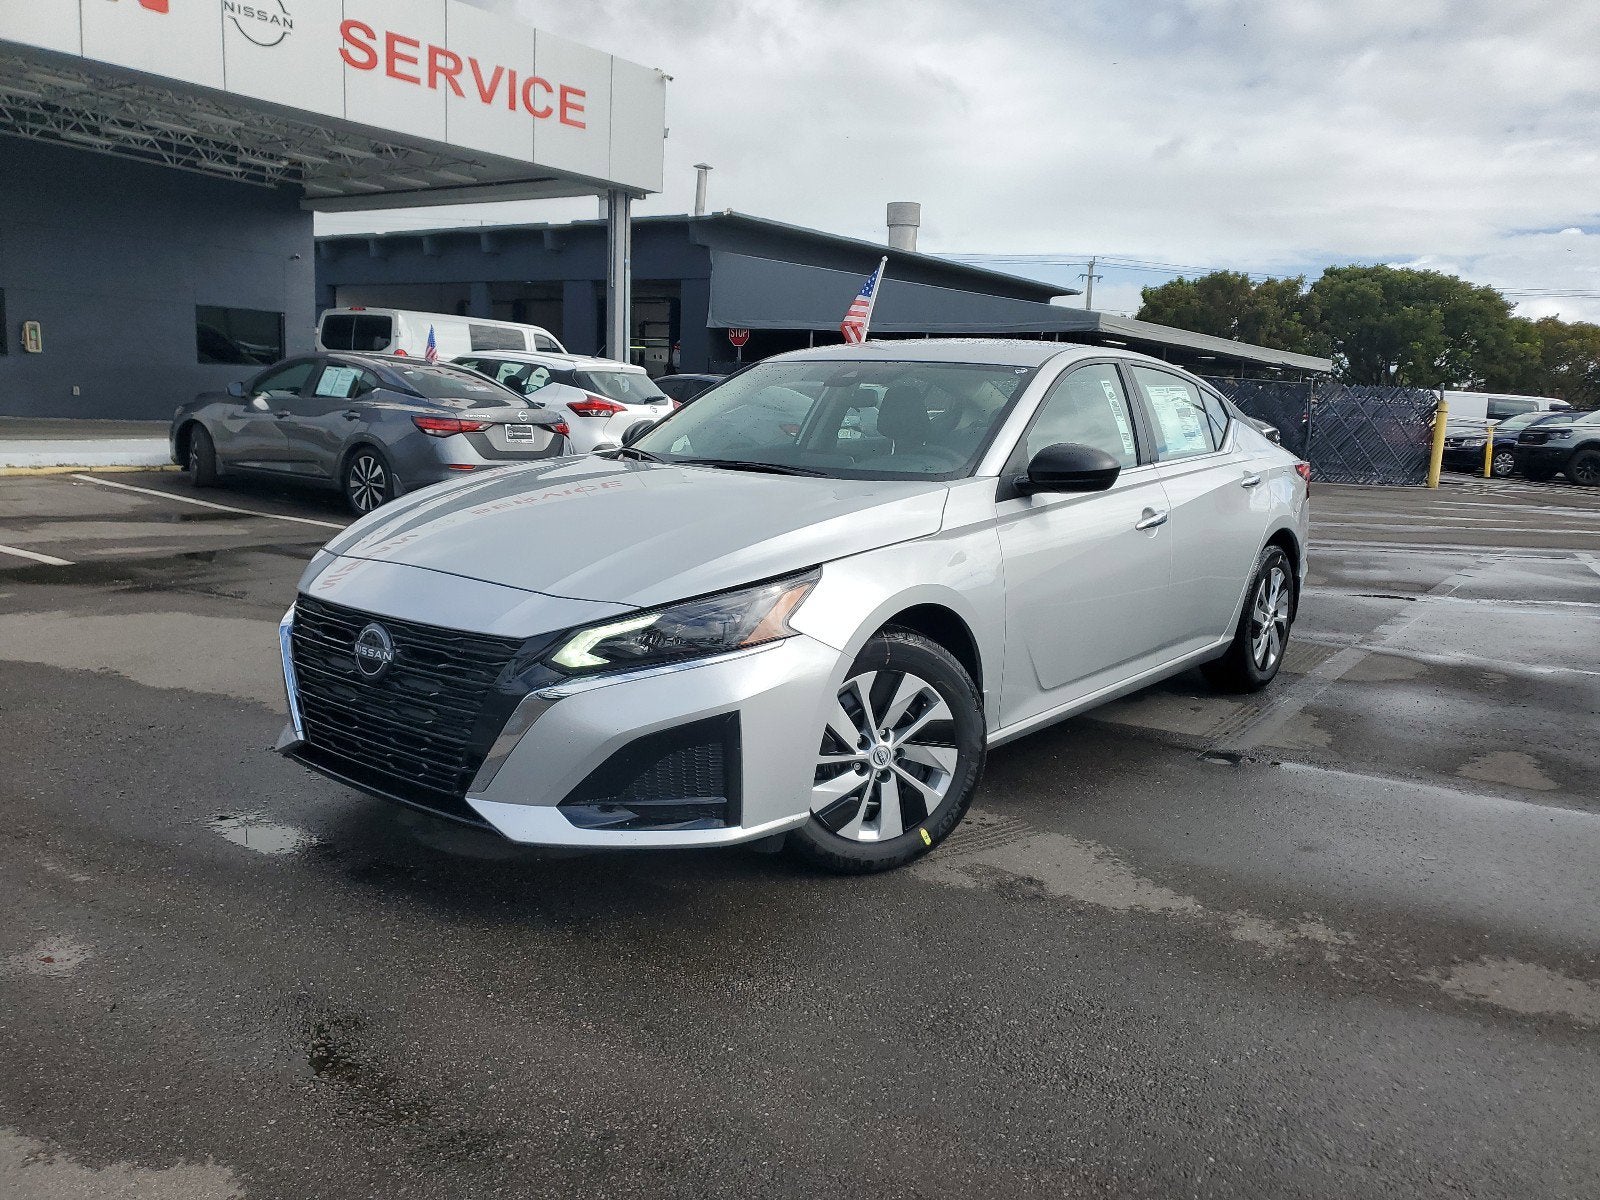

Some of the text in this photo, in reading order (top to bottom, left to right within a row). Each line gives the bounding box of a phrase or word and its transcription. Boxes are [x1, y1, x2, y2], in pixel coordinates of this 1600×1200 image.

[223, 0, 293, 29] NISSAN
[338, 19, 587, 130] SERVICE
[730, 328, 748, 338] STOP
[355, 643, 392, 661] NISSAN
